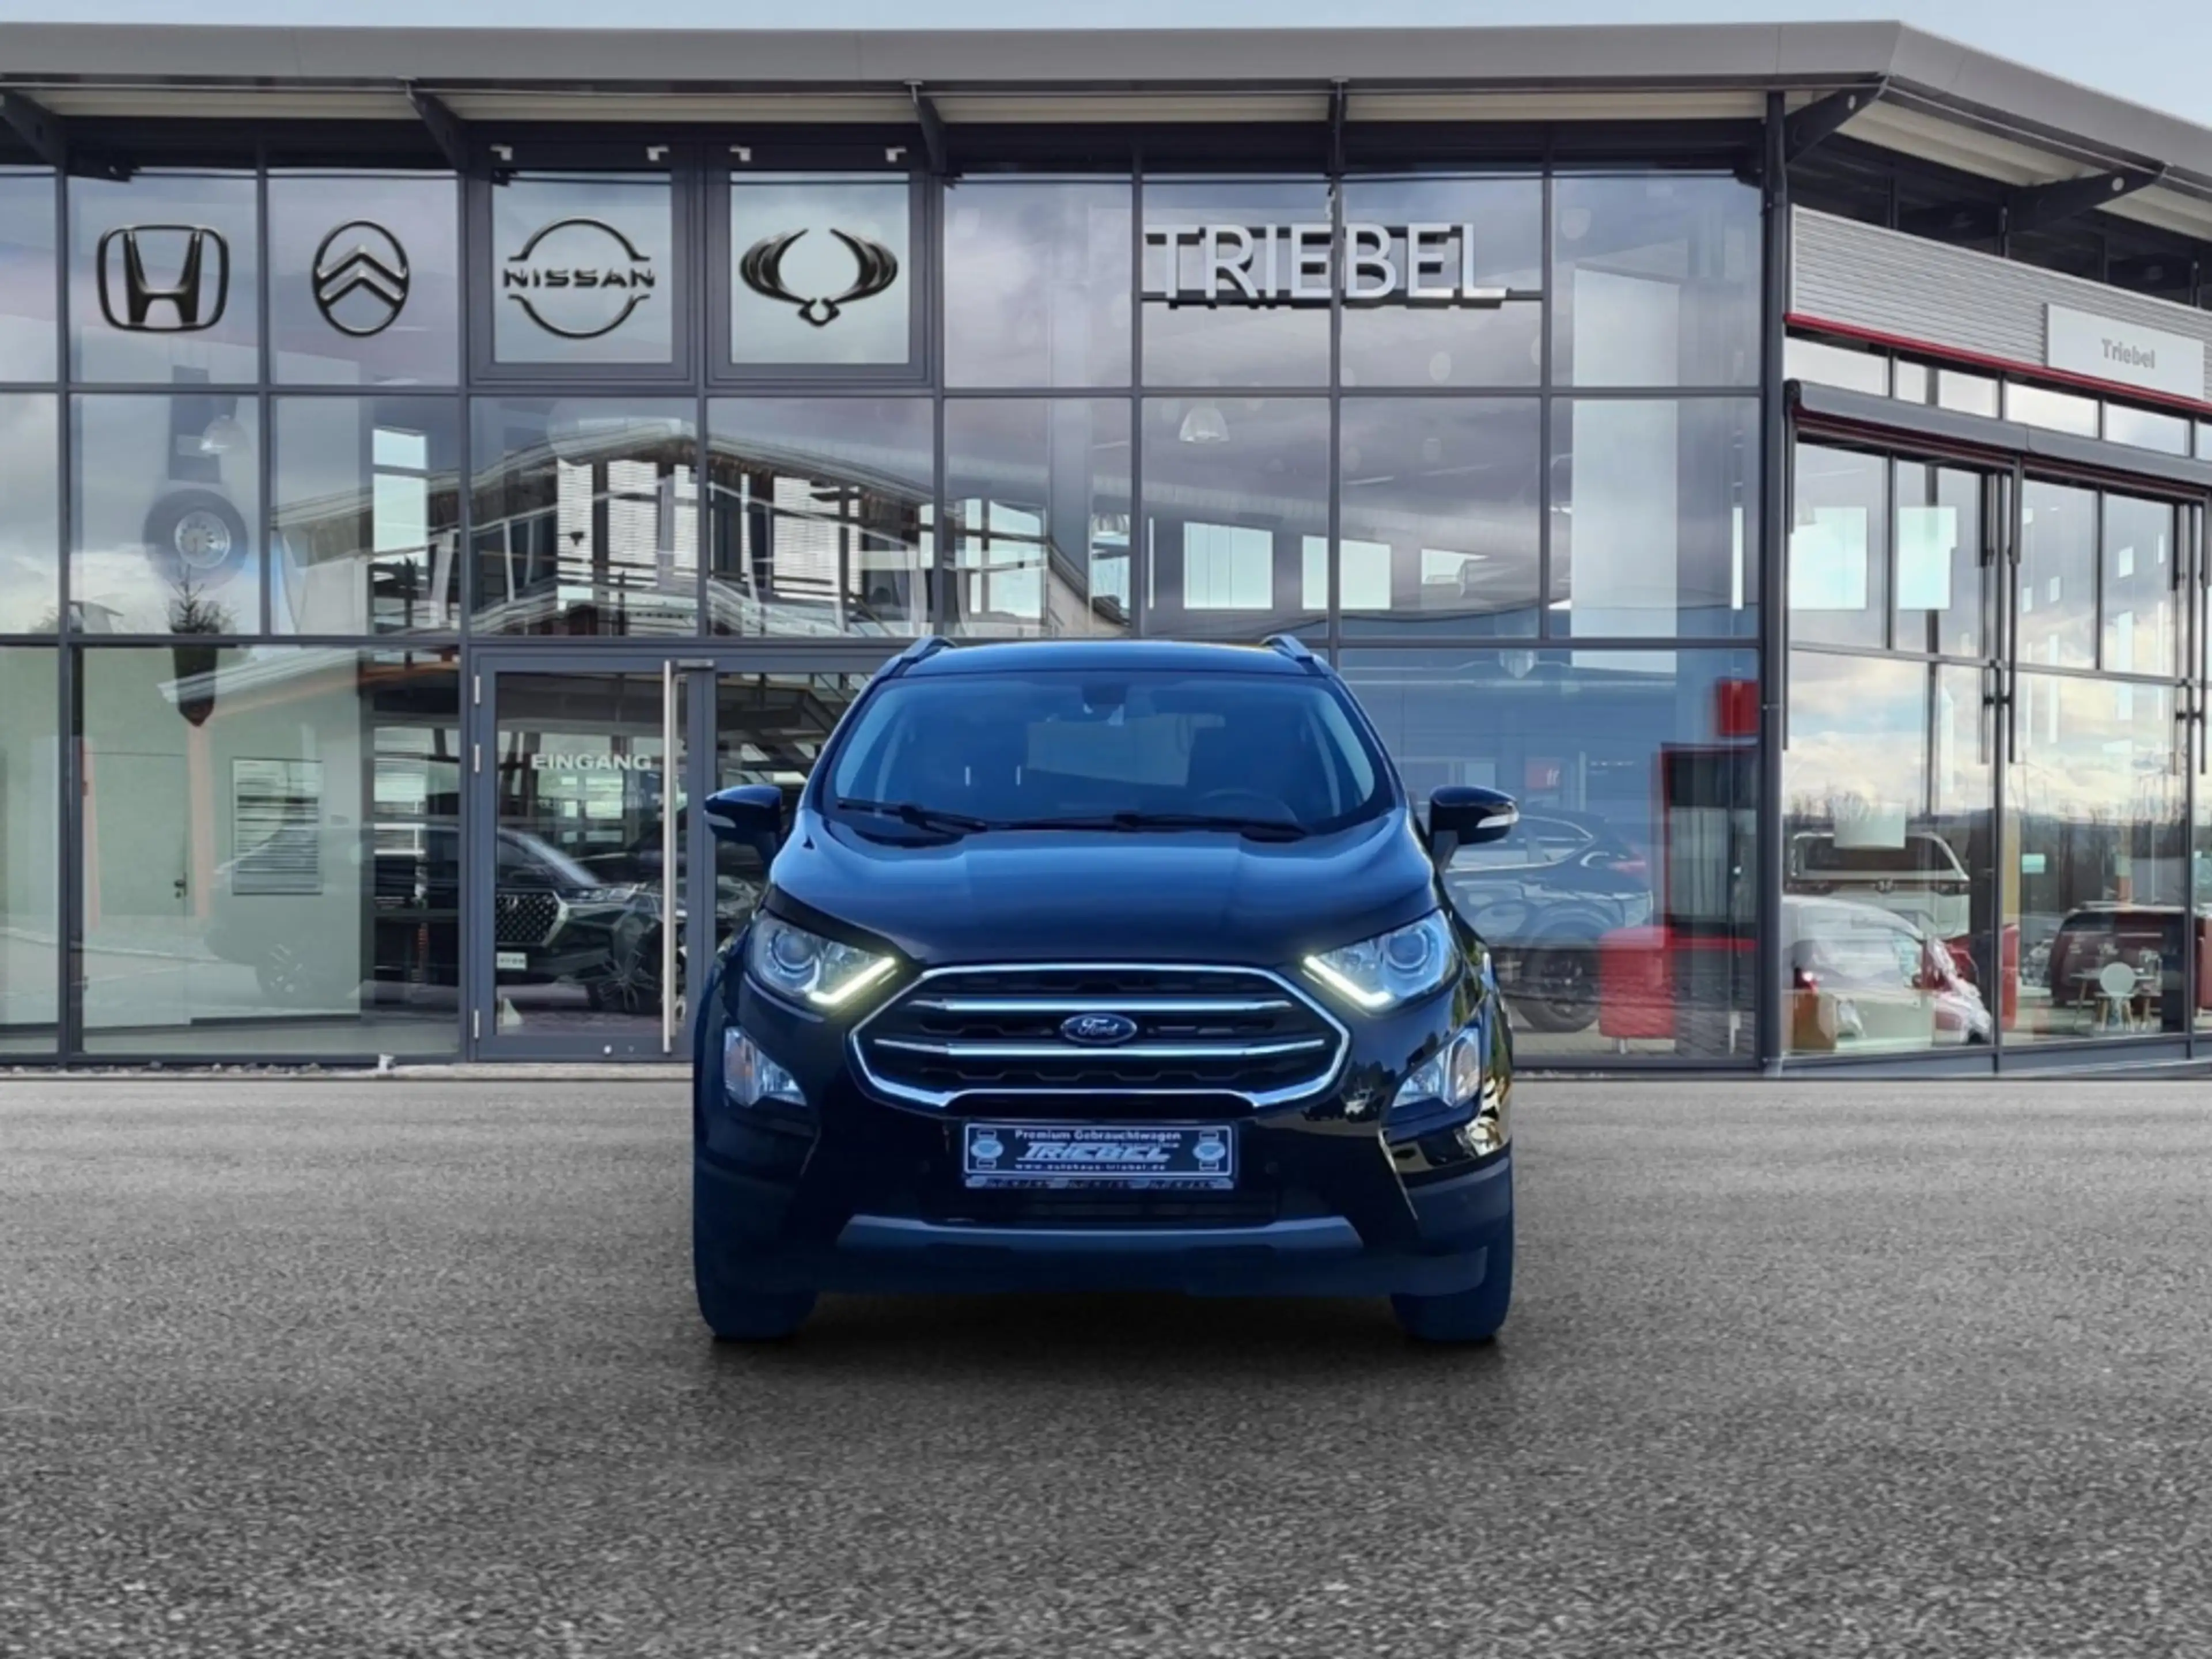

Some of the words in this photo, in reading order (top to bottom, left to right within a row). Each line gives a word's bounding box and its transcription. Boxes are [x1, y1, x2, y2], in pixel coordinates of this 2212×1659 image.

[1143, 223, 1507, 299] TRIEBEL
[503, 268, 655, 287] NISSAN
[2101, 337, 2156, 370] Triebel
[531, 753, 652, 771] EINGANG
[1014, 1129, 1070, 1139] Premium
[1073, 1129, 1181, 1142] Gebrauchtwagen
